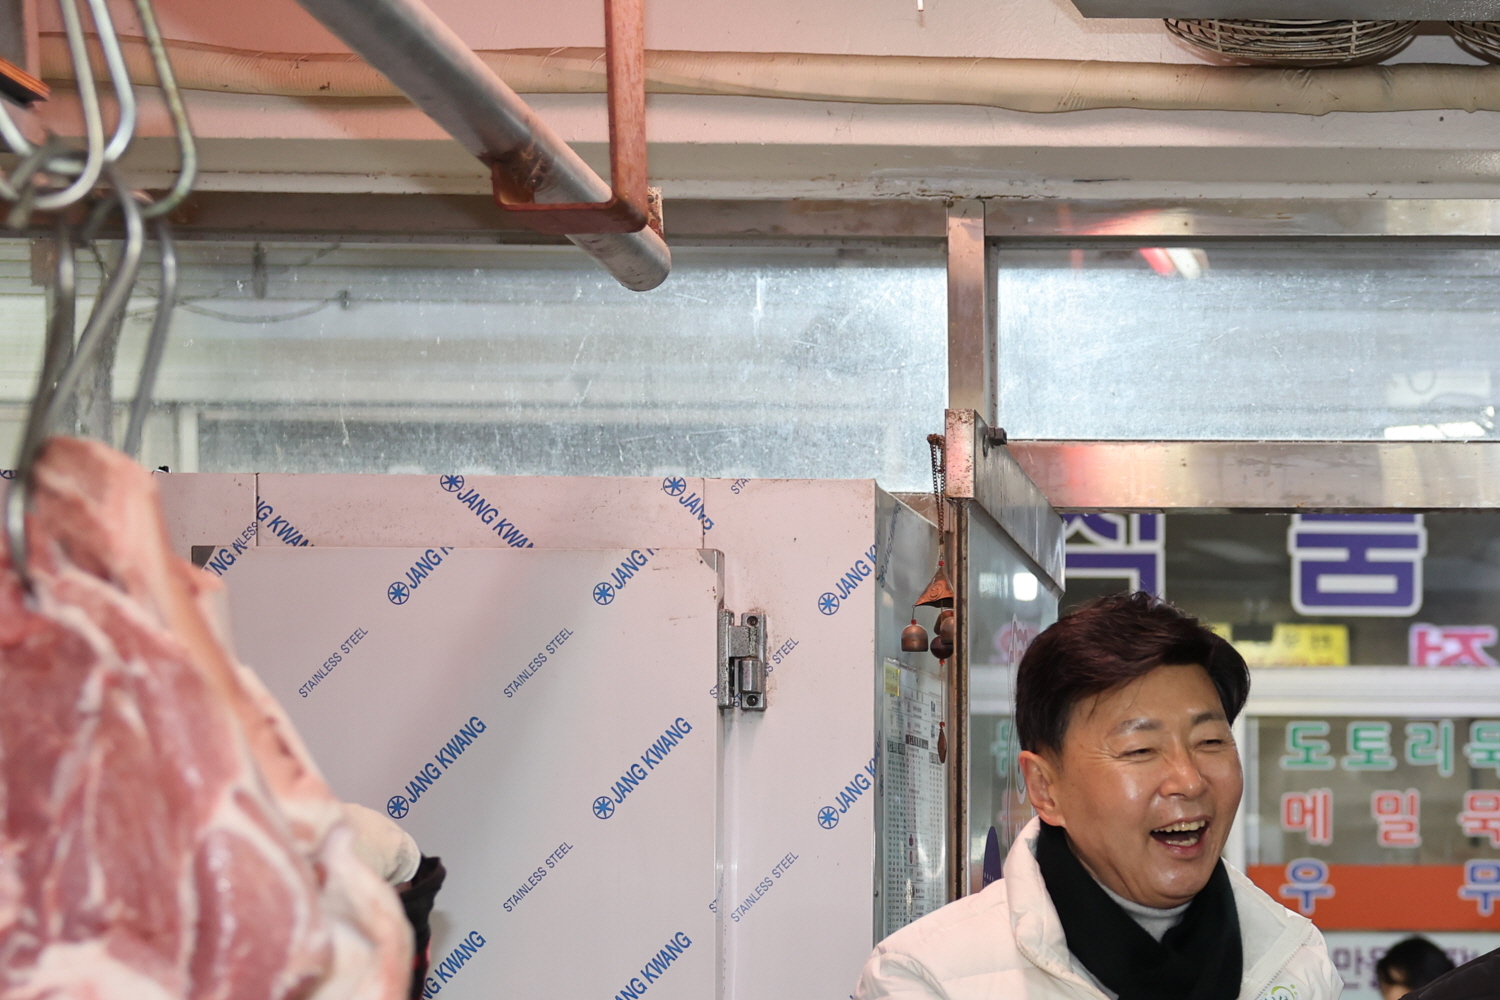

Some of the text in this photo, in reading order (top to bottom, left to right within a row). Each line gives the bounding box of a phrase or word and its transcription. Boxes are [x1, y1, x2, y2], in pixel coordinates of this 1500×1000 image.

[457, 489, 534, 548] JANG KWA
[405, 549, 443, 589] JANG
[611, 549, 649, 590] JANG
[834, 559, 870, 600] JANG
[298, 627, 369, 699] STAINLESS STEEL
[503, 627, 574, 699] STAINLESS STEEL
[772, 638, 799, 665] STEEL
[404, 716, 487, 804] JANG KWANG
[612, 716, 693, 804] JANG KWANG
[835, 773, 872, 814] JANG
[503, 841, 574, 913] STAINLESS STEEL
[730, 852, 799, 922] STAINLESS STEEL
[435, 930, 487, 984] KWANG
[640, 931, 693, 986] KWANG
